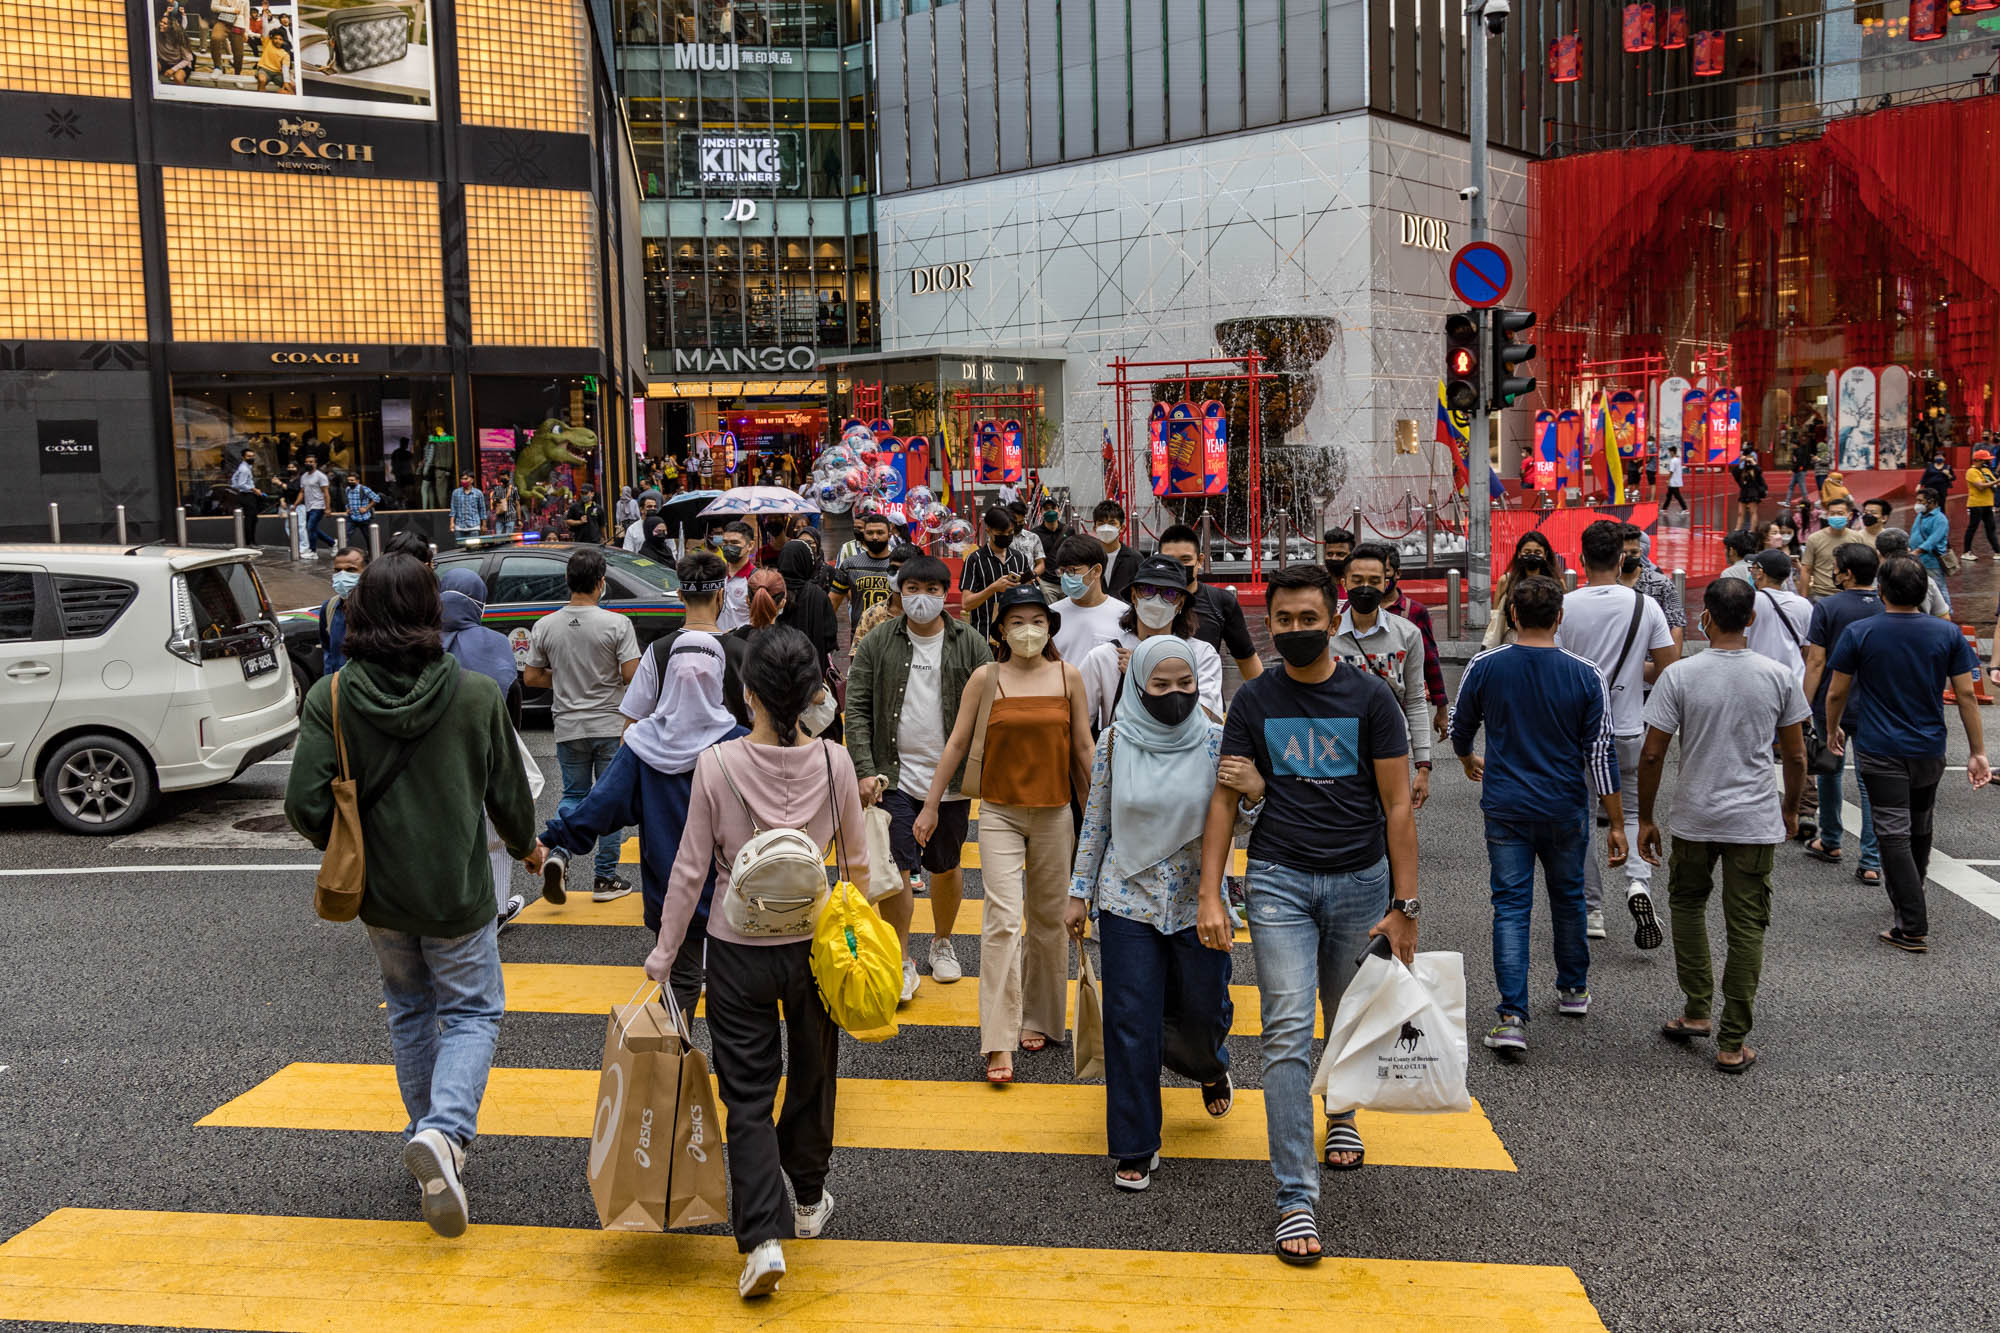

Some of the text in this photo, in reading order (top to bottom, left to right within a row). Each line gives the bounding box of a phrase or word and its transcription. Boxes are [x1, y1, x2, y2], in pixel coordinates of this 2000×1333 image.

[674, 43, 739, 71] MUJI
[742, 51, 793, 65] 無印良品
[230, 136, 374, 162] COACH
[698, 138, 780, 149] UNDISPUTED
[277, 161, 331, 170] NEW YORK
[698, 148, 781, 172] KING
[700, 172, 780, 182] OF TRAINERS
[724, 198, 757, 222] JD
[1400, 213, 1451, 252] DIOR
[911, 263, 975, 296] DIOR
[271, 351, 360, 364] COACH
[675, 346, 816, 372] MANGO
[1006, 446, 1019, 456] YEAR
[1207, 439, 1224, 453] YEAR
[1536, 462, 1553, 471] YEAR
[856, 576, 889, 591] TOKY
[639, 1108, 653, 1148] asics
[691, 1104, 704, 1144] asics
